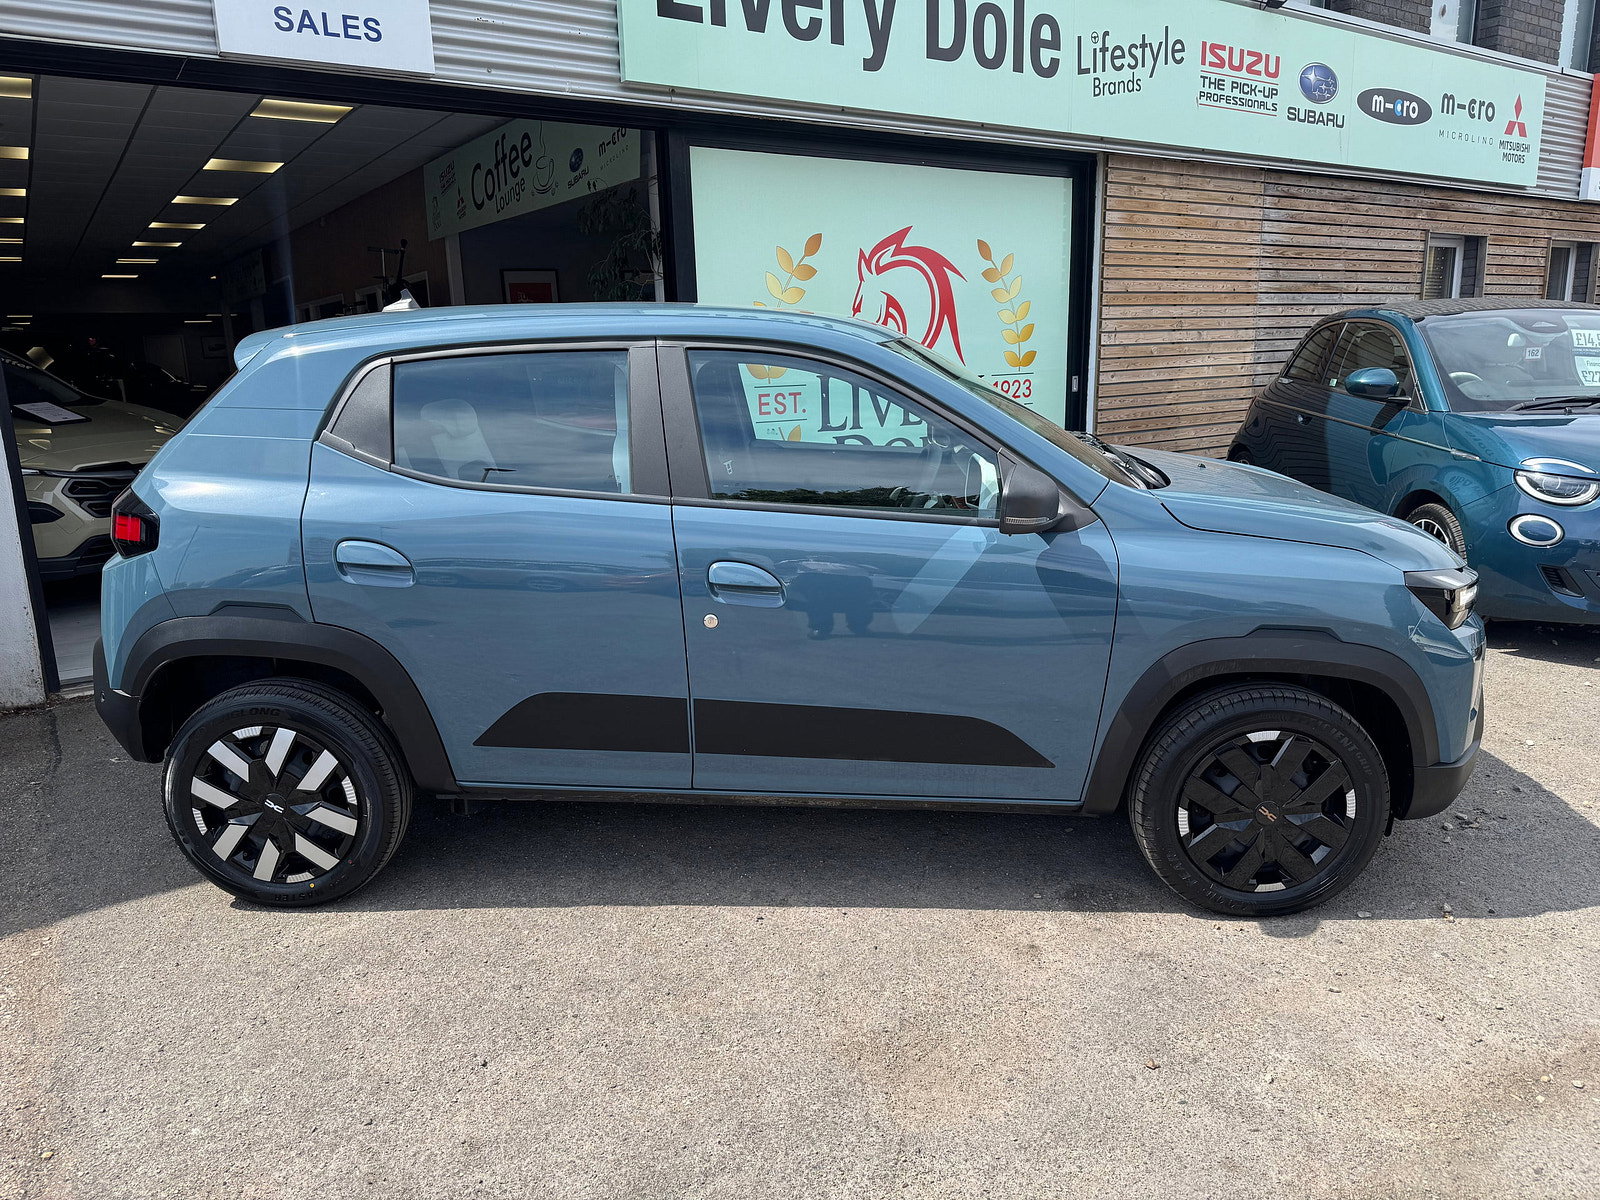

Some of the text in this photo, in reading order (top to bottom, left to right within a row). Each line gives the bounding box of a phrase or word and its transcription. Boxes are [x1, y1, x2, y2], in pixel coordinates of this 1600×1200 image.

[273, 6, 383, 43] SALES
[657, 0, 1061, 78] very Dole
[1077, 26, 1186, 78] Lifestyle
[1200, 41, 1281, 78] ISUZU
[1093, 72, 1142, 97] Brands
[1200, 76, 1279, 99] THE PICK-UP
[1199, 91, 1278, 112] PROFESSIONALS
[1287, 107, 1345, 129] SUBARU
[1439, 129, 1494, 145] MICROLINO
[1498, 140, 1531, 153] MITSUBISHI
[1502, 152, 1526, 164] MOTORS
[471, 132, 533, 210] Coffee
[567, 165, 589, 189] SUBARU
[495, 177, 526, 214] Lounge
[1527, 349, 1540, 357] 162
[757, 391, 807, 416] EST.
